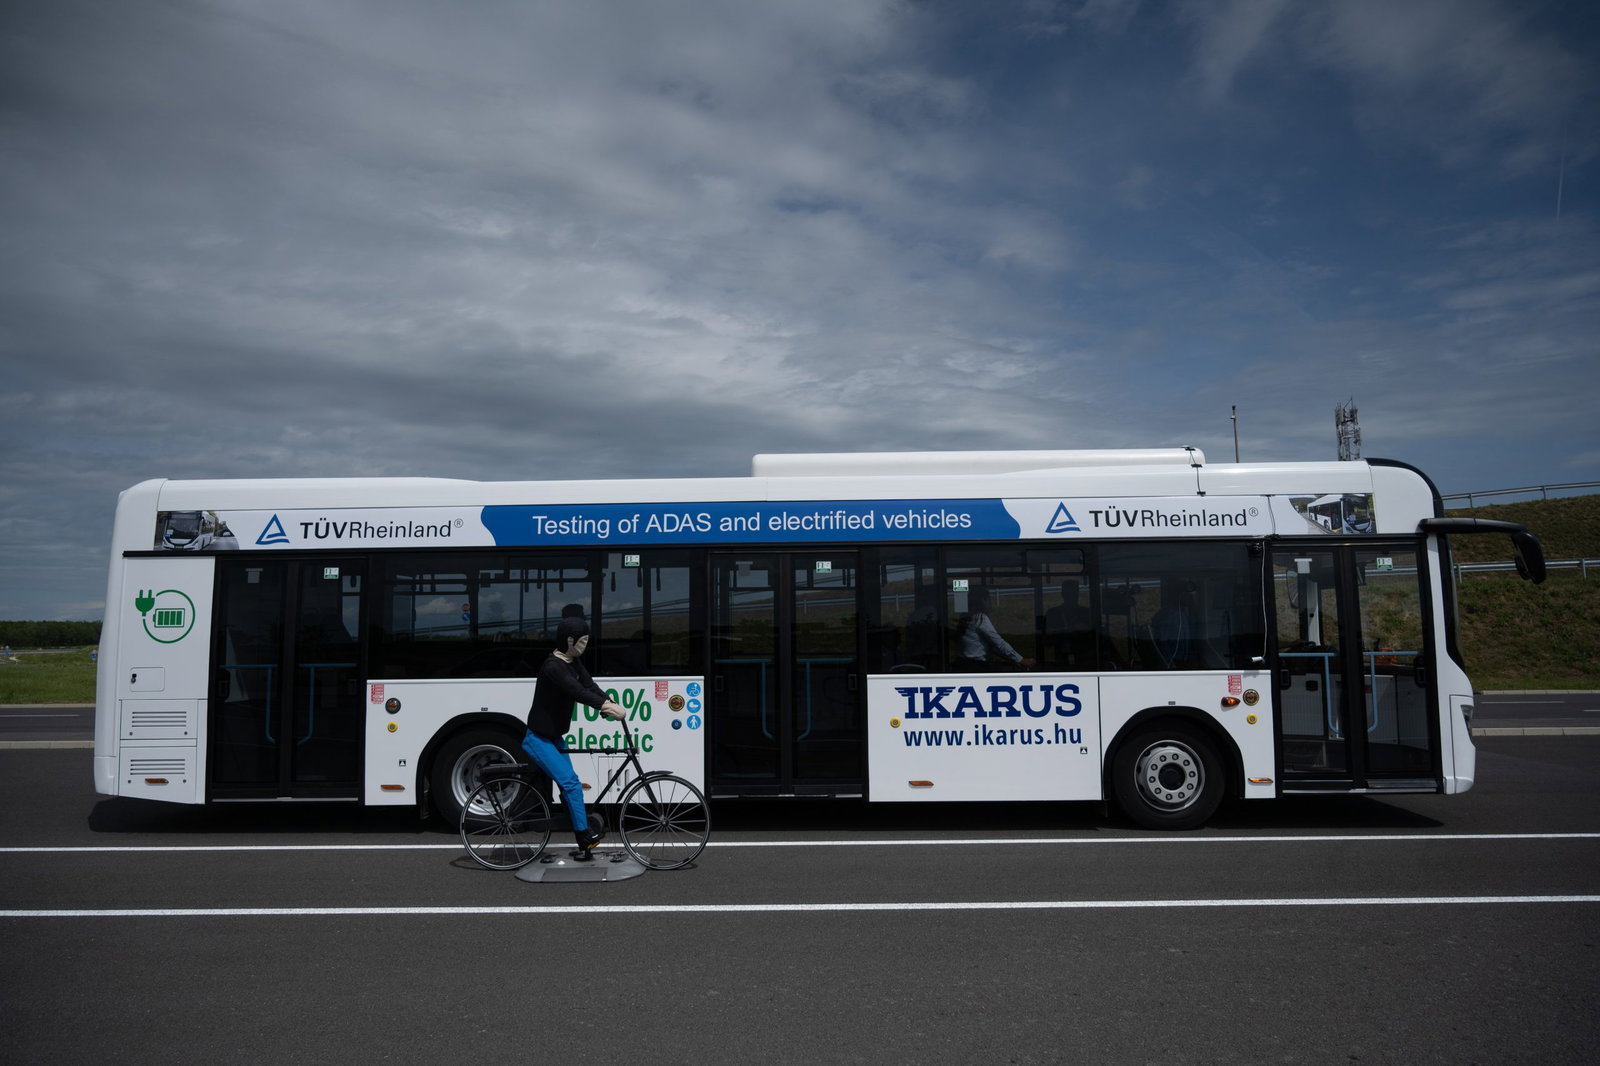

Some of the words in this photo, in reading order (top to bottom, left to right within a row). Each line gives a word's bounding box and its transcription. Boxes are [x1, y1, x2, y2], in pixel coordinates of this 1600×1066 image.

[532, 515, 610, 539] Testing
[617, 513, 640, 534] of
[646, 512, 712, 533] ADAS
[719, 511, 760, 532] and
[768, 510, 875, 531] electrified
[882, 509, 972, 529] vehicles
[894, 684, 1082, 719] IKARUS
[565, 728, 653, 752] electric
[902, 723, 1082, 747] www.ikarus.hu
